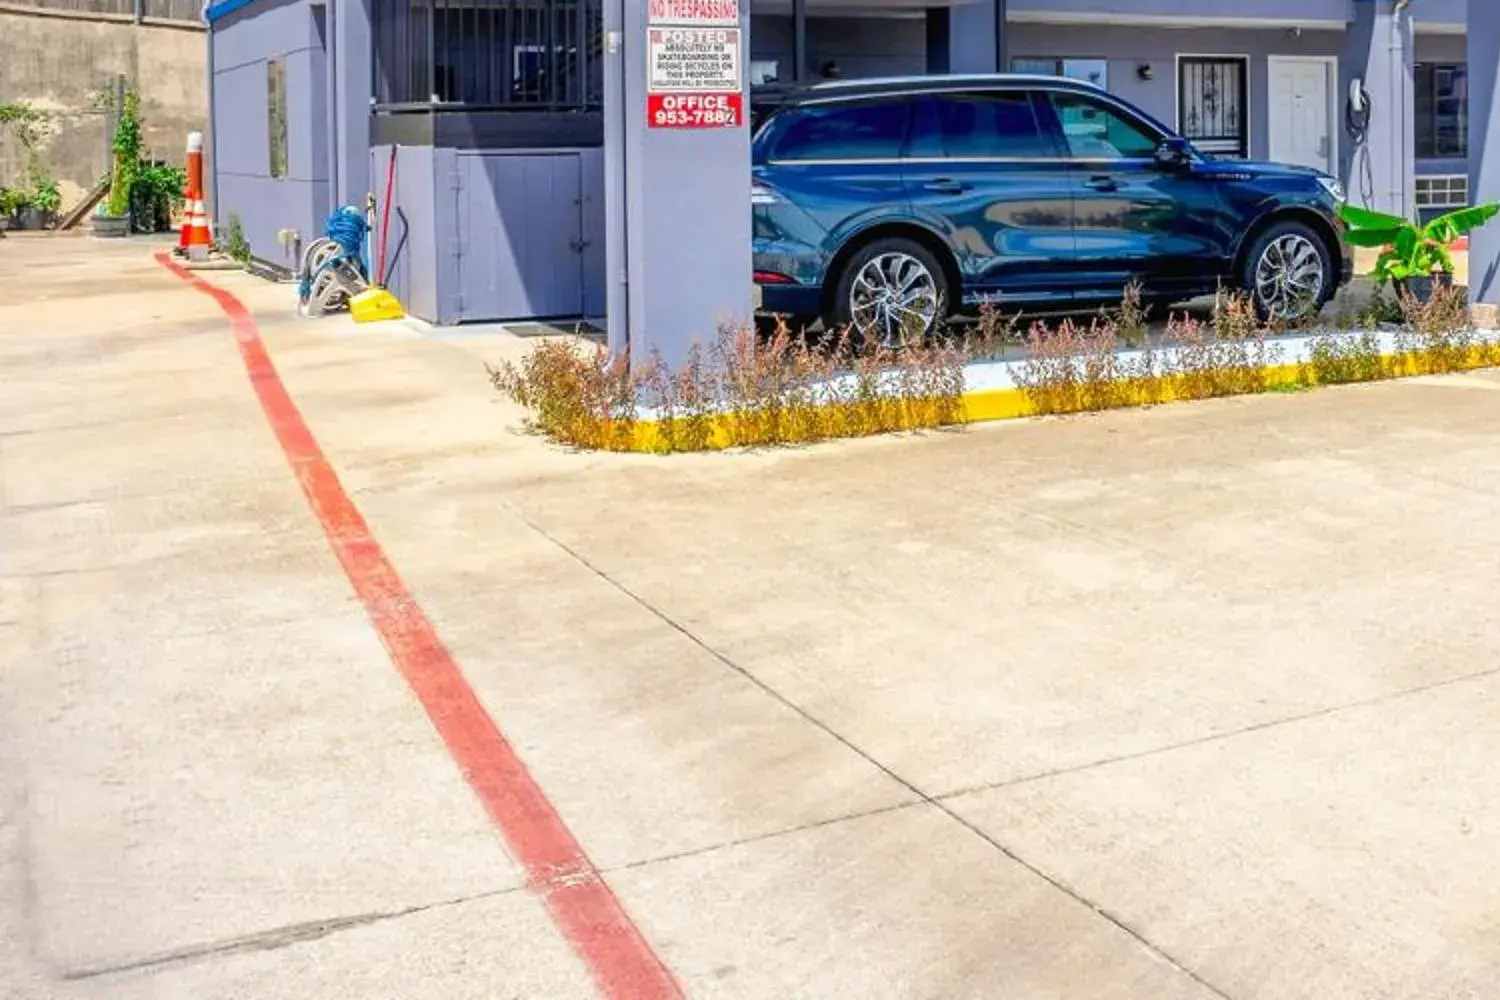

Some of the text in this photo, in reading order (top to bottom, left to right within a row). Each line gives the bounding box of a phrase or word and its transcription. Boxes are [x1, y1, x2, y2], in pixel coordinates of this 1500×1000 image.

[651, 0, 737, 19] NO TRESPASSING
[661, 31, 727, 42] POSTED
[657, 53, 719, 61] SKATEBOARDING
[663, 96, 728, 109] OFFICE
[655, 110, 736, 126] 953-7882
